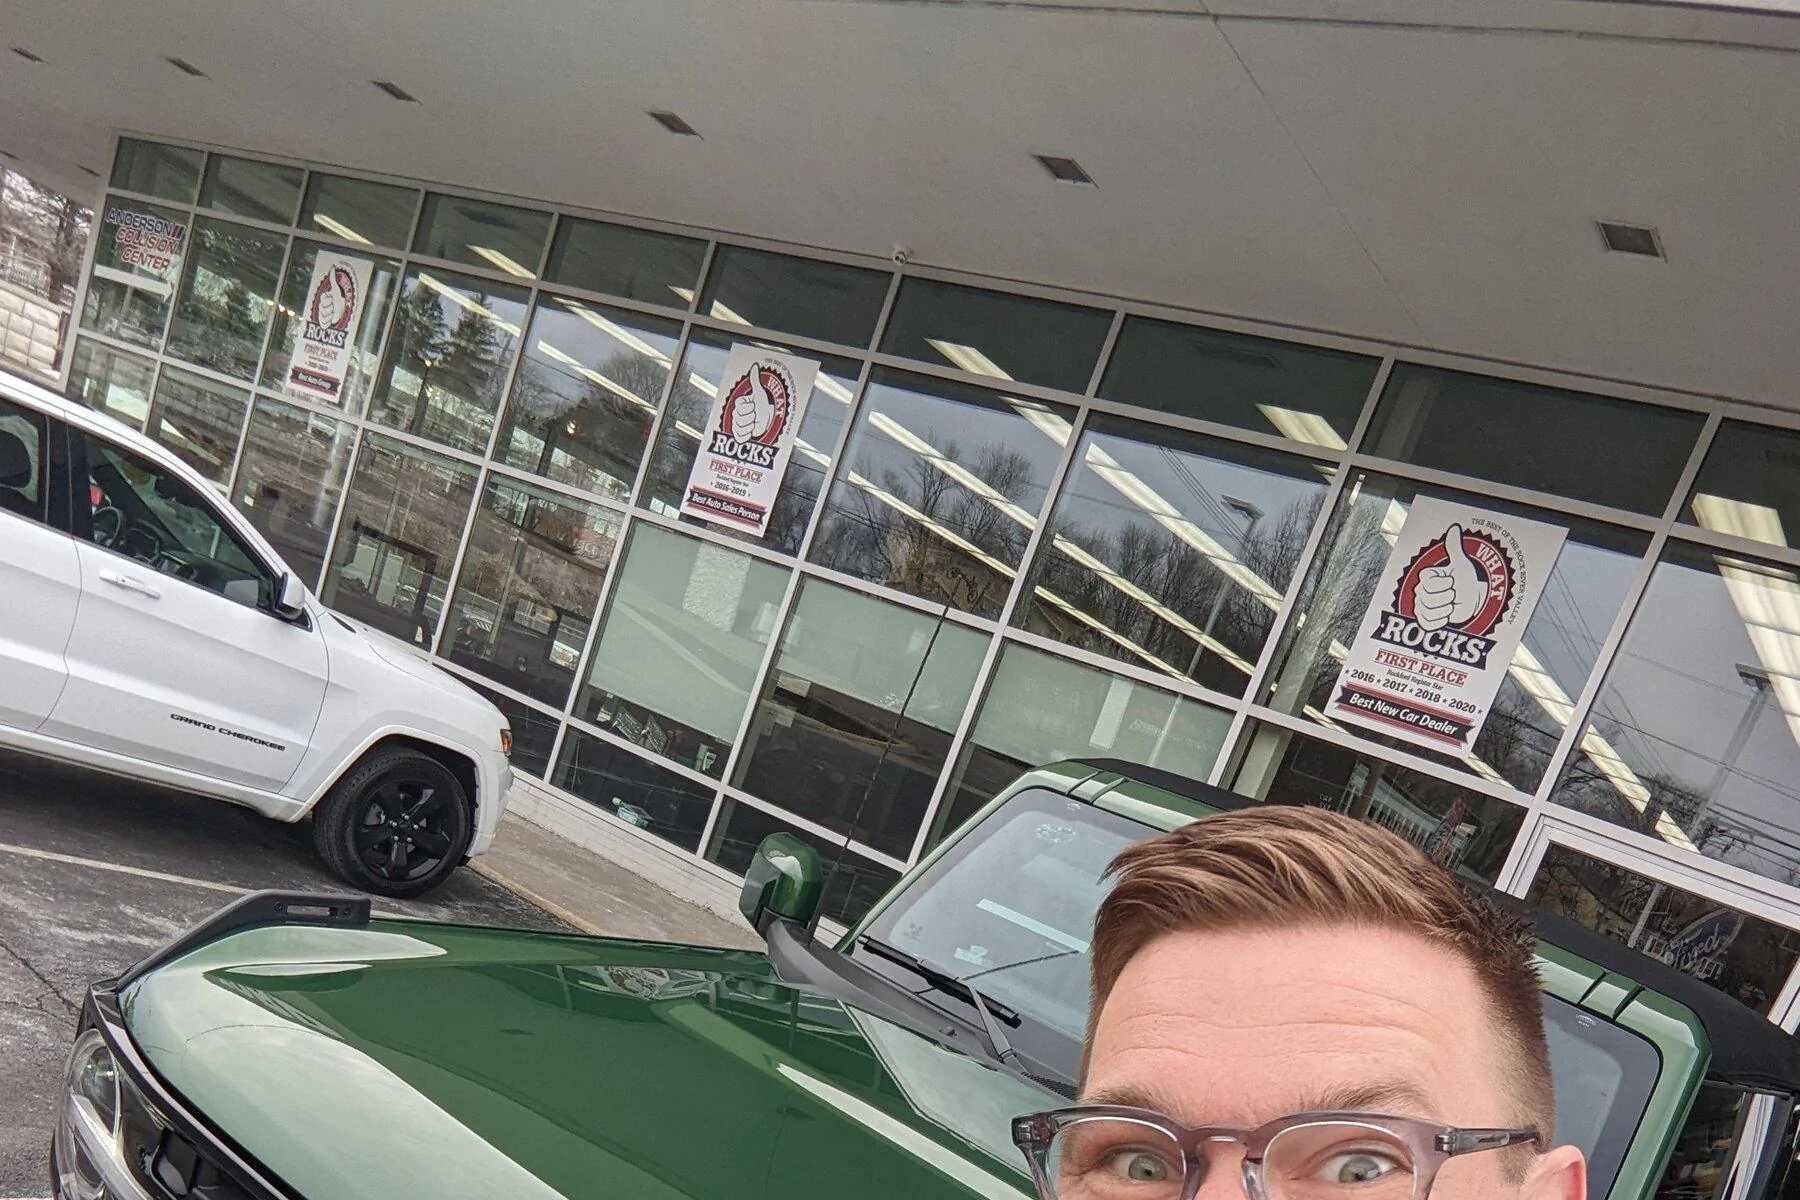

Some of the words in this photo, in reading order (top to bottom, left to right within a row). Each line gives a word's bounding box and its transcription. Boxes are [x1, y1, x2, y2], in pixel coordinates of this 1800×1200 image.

[107, 208, 173, 236] ANDERSON
[115, 227, 181, 254] COLLISION
[122, 248, 170, 272] CENTER
[306, 323, 346, 347] ROCKS
[767, 376, 785, 418] WHAT
[713, 434, 773, 466] ROCKS
[709, 460, 735, 474] FIRST
[735, 466, 763, 483] PLACE
[714, 481, 747, 497] 2016-2019
[692, 493, 706, 504] Best
[706, 497, 721, 509] Auto
[721, 502, 738, 514] Sales
[738, 506, 760, 520] Person
[1471, 518, 1485, 526] THE
[1485, 519, 1502, 532] BEST
[1501, 529, 1511, 540] OF
[1508, 536, 1520, 551] THE
[1475, 542, 1506, 600] WHAT
[1516, 550, 1526, 570] ROCK
[1508, 595, 1523, 624] VALLEY
[1380, 615, 1486, 664] ROCKS
[1375, 650, 1418, 671] FIRST
[1419, 661, 1468, 686] PLACE
[1386, 668, 1411, 681] Rockford
[1431, 682, 1444, 691] Star
[1350, 669, 1376, 683] 2016
[1382, 678, 1408, 693] 2017
[1414, 688, 1441, 703] 2018
[1448, 698, 1477, 714] 2020
[1349, 693, 1373, 709] Best
[1373, 701, 1399, 717] New
[1399, 709, 1420, 723] Car
[1418, 714, 1459, 735] Dealer
[170, 713, 216, 731] GRAND
[218, 727, 286, 752] CHEROKEE
